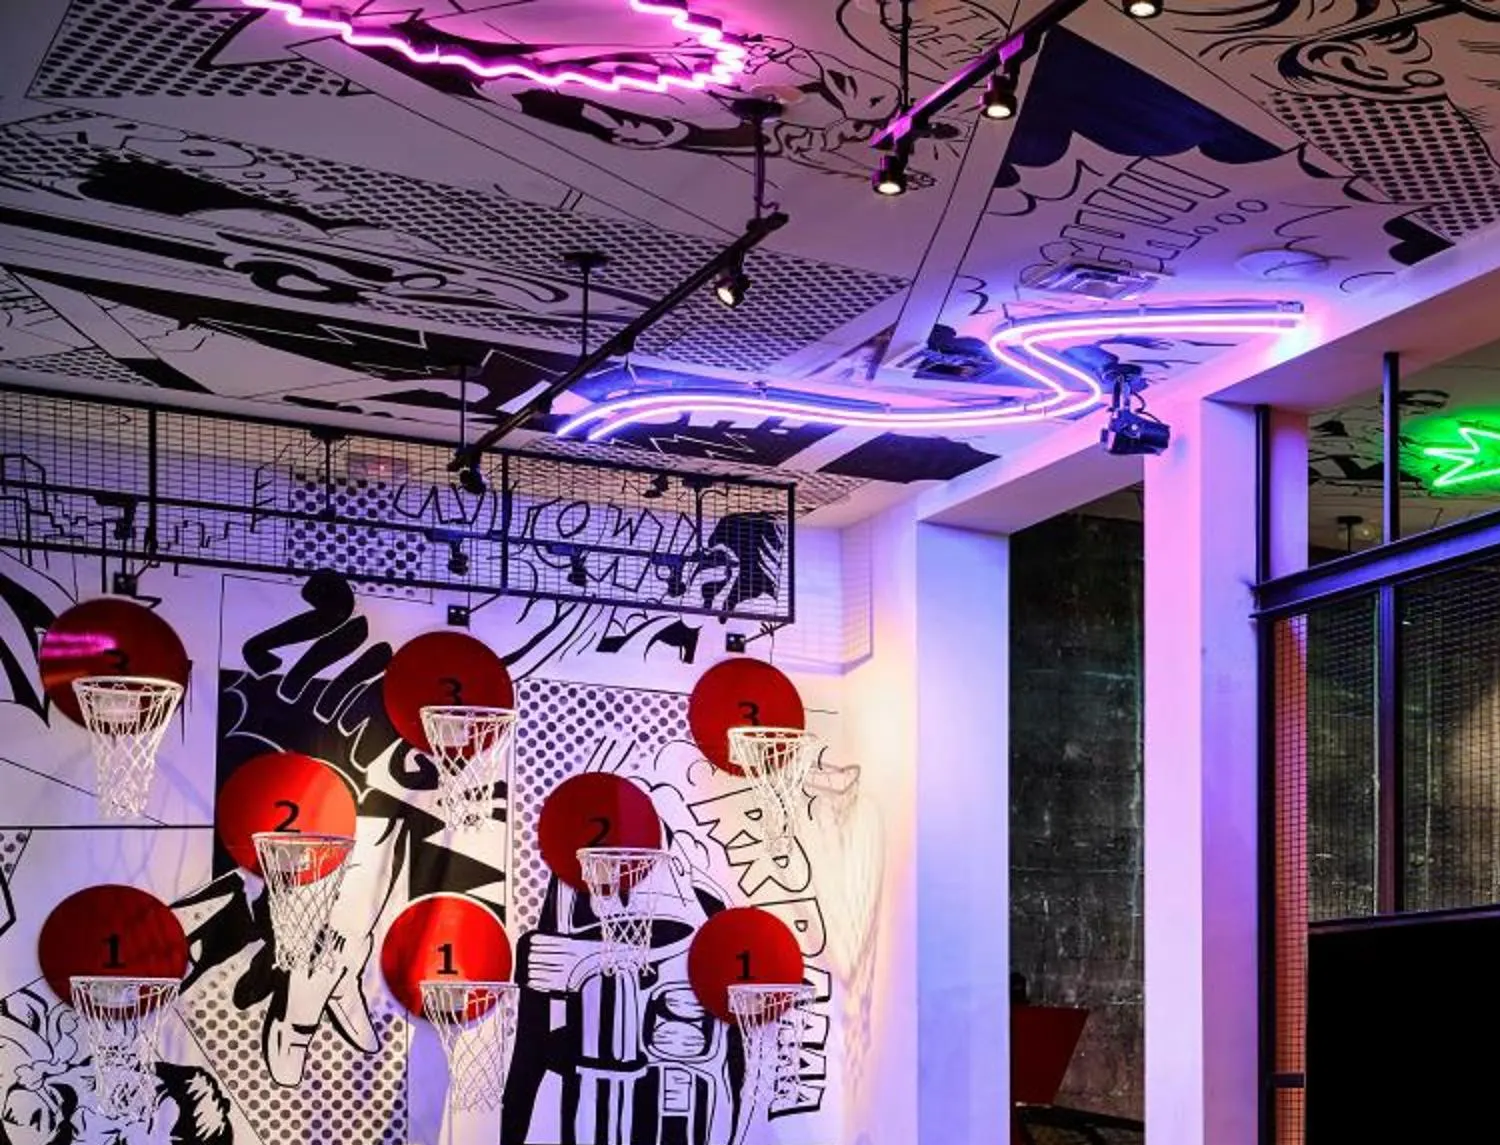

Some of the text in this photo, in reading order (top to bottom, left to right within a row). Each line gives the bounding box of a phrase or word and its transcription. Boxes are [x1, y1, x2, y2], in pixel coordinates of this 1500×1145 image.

[273, 802, 301, 834] 2
[587, 818, 612, 848] 2
[102, 936, 127, 967] 1
[437, 943, 458, 975] 1
[736, 952, 754, 981] 1
